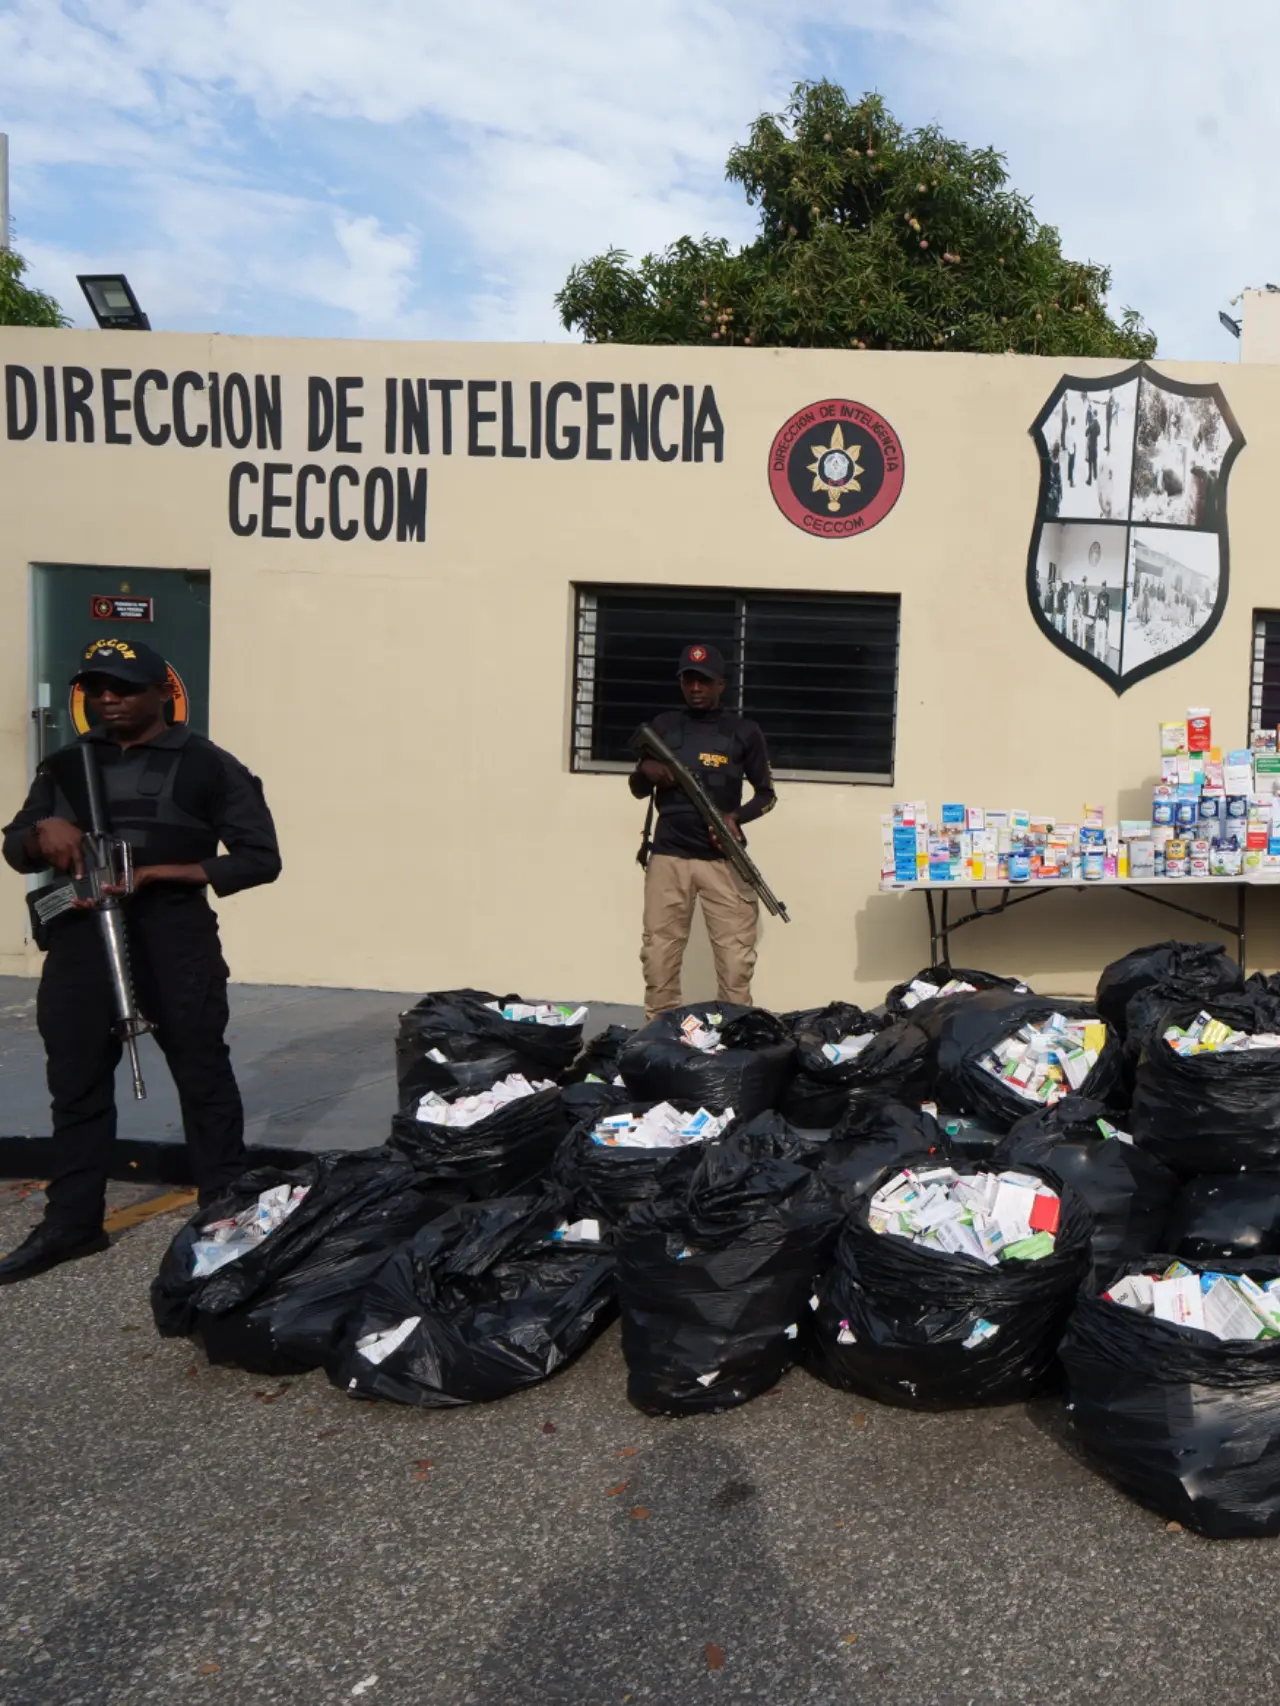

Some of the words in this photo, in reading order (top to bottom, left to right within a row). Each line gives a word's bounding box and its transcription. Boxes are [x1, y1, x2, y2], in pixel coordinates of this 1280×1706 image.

[5, 364, 282, 450] DIRECCION
[307, 375, 365, 453] DE
[385, 377, 725, 463] INTELIGENCIA
[773, 412, 816, 471] DIRECCION
[819, 404, 837, 418] DE
[841, 405, 899, 472] INTELIGENCIA
[228, 461, 428, 543] CECCOM
[803, 514, 865, 533] CECCOM
